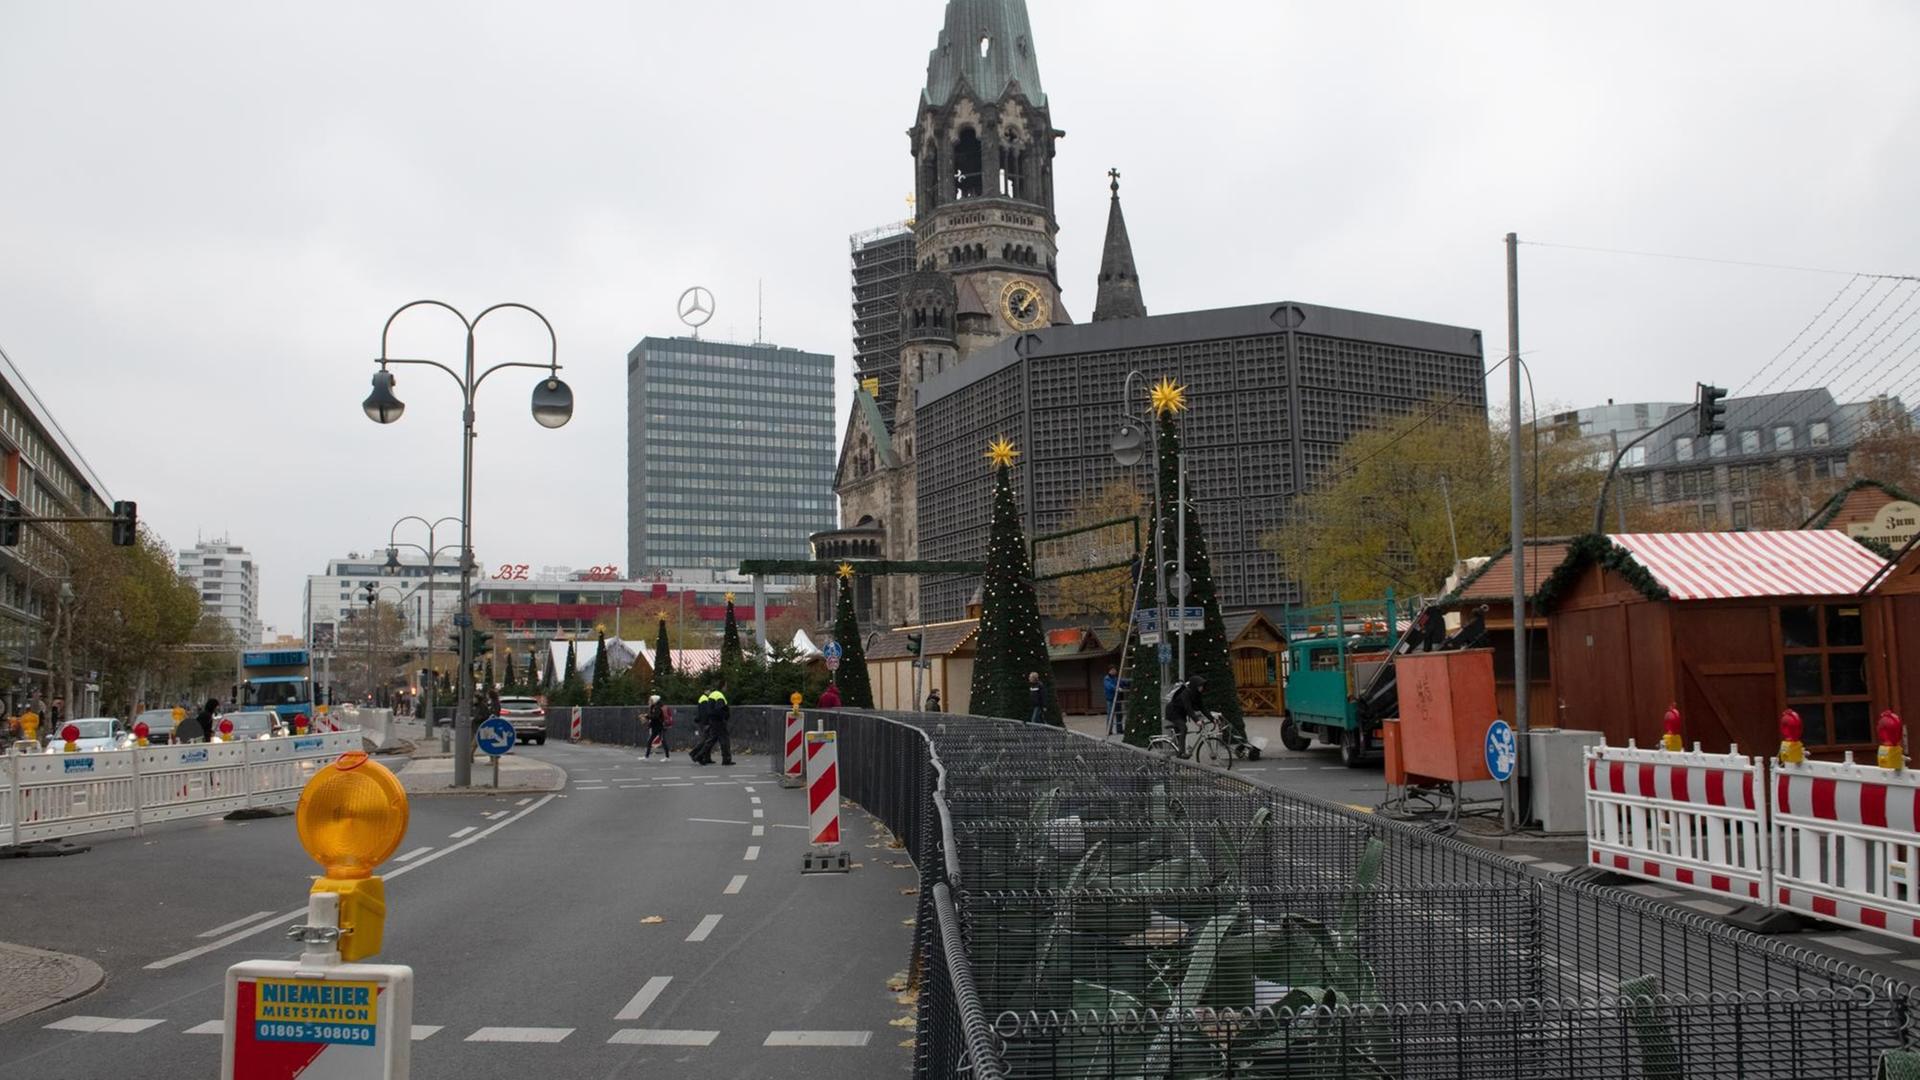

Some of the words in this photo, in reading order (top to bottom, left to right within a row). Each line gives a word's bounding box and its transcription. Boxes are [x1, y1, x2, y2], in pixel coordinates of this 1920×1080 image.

[262, 983, 370, 1007] NIEMEIER
[262, 1006, 369, 1021] MIETSTATION
[259, 1024, 371, 1041] 01805-308050
